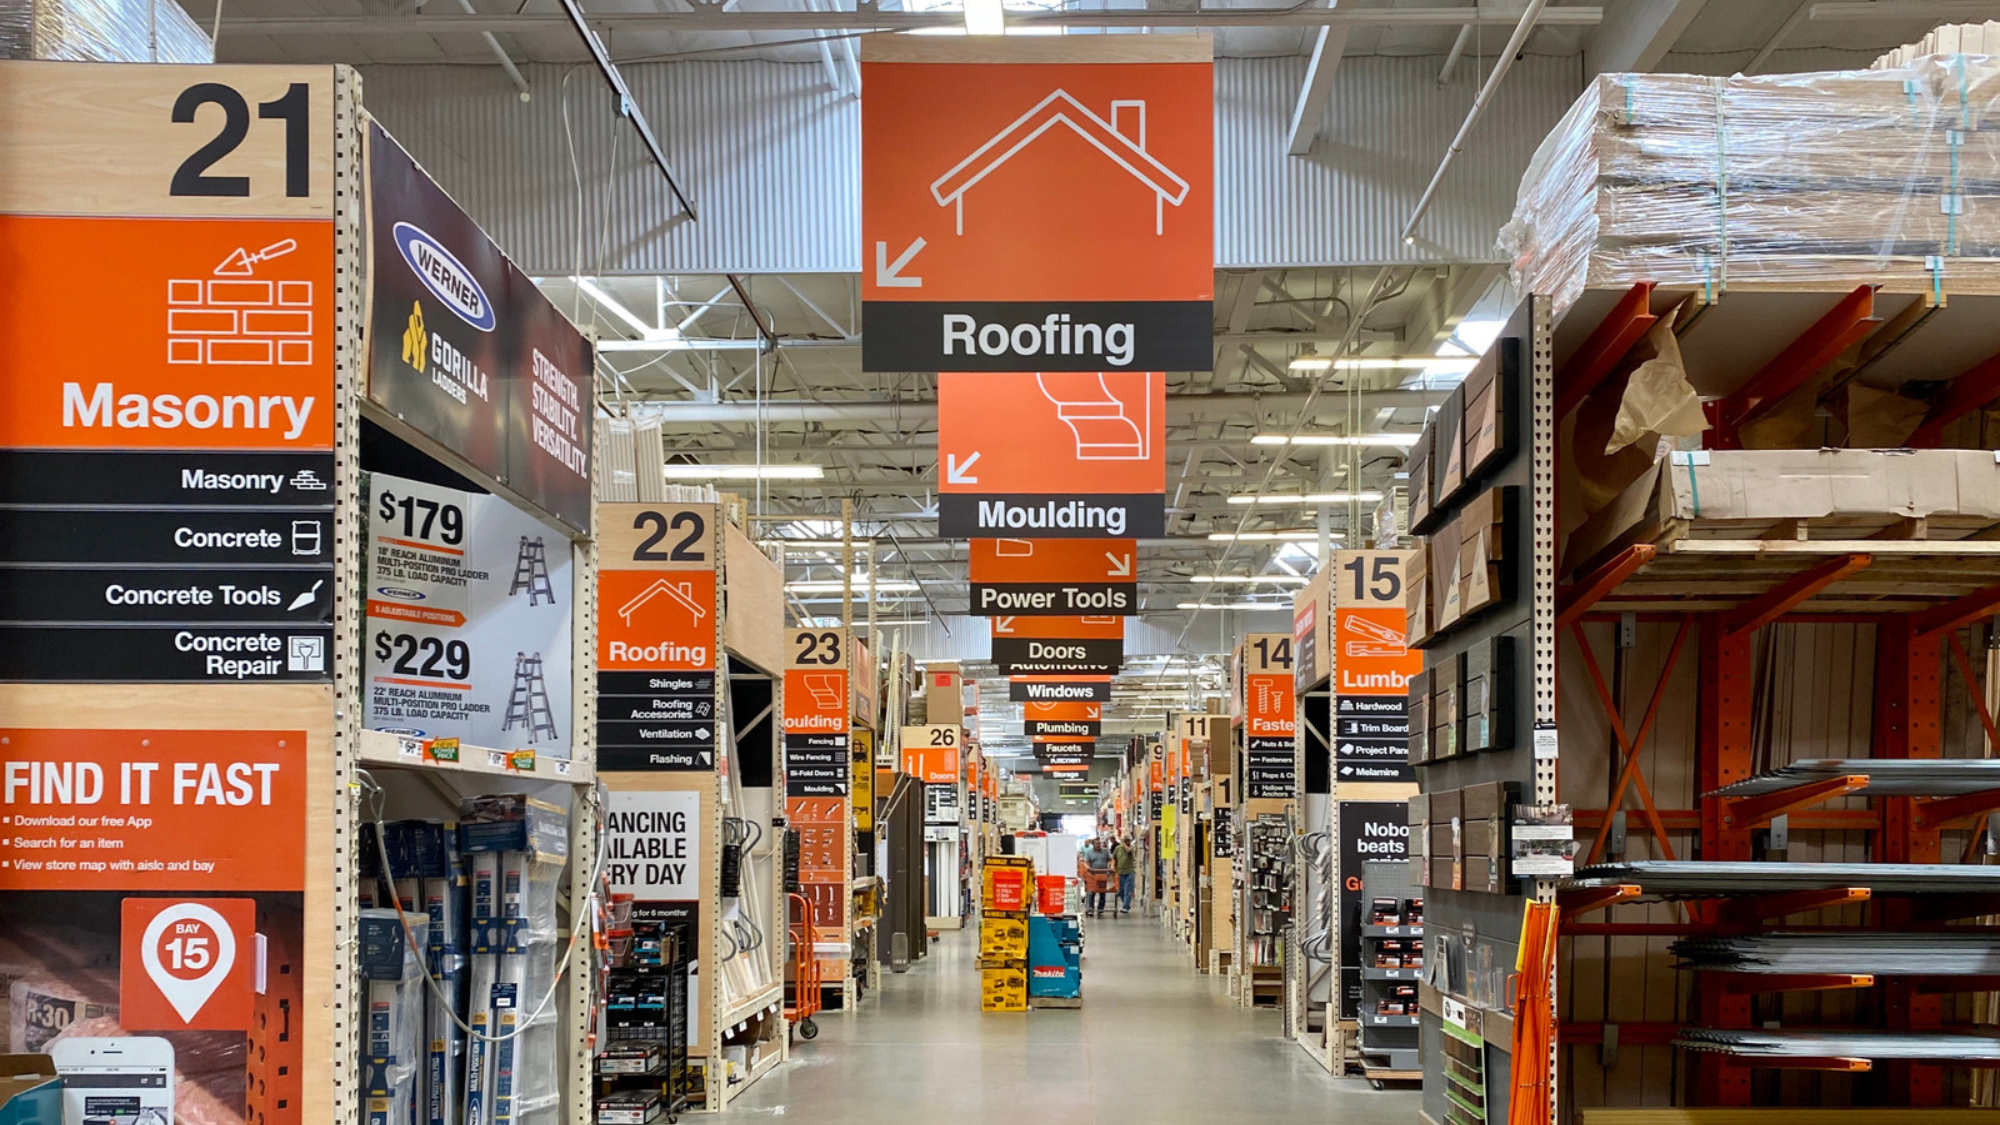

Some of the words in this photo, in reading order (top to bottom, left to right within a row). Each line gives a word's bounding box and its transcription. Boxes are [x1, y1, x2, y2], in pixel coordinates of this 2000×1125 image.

[170, 82, 309, 198] 21
[417, 243, 481, 316] WERNER
[943, 313, 1135, 366] Roofing
[431, 332, 489, 403] GORILLA
[432, 369, 467, 405] LADDERS
[63, 382, 315, 440] Masonry
[182, 469, 285, 494] Masonry
[379, 489, 464, 546] $179
[978, 500, 1126, 536] Moulding
[174, 528, 282, 548] Concrete
[633, 510, 705, 562] 22
[391, 548, 417, 561] REACH
[419, 553, 461, 568] ALUMINUM
[377, 556, 439, 574] MULTI-POSITION
[441, 566, 457, 577] PRO
[458, 568, 489, 580] LADDER
[377, 566, 392, 576] 375
[408, 571, 429, 582] LOAD
[431, 575, 468, 587] CAPACITY
[1344, 556, 1401, 601] 15
[105, 584, 213, 605] Concrete
[219, 585, 281, 606] Tools
[387, 589, 416, 598] WERNER
[981, 588, 1055, 609] Power
[1062, 588, 1127, 609] Tools
[381, 606, 421, 618] ADJUSTABLE
[422, 611, 455, 623] POSITIONS
[175, 632, 282, 653] Concrete
[795, 632, 841, 665] 23
[1029, 643, 1086, 659] Doors
[375, 630, 471, 681] $229
[609, 641, 706, 668] Roofing
[1253, 637, 1293, 669] 14
[206, 655, 282, 679] Repair
[649, 679, 693, 690] Shingles
[1027, 685, 1094, 698] Windows
[389, 687, 416, 698] REACH
[418, 689, 462, 701] ALUMINUM
[373, 696, 439, 709] MULTI-POSITION
[441, 702, 457, 711] PRO
[459, 703, 490, 713] LADDER
[652, 700, 693, 711] Roofing
[1356, 702, 1402, 711] Hardwood
[373, 707, 389, 716] 375
[406, 709, 428, 718] LOAD
[430, 711, 470, 721] CAPACITY
[631, 710, 693, 720] Accessories
[785, 715, 842, 731] oulding
[1037, 723, 1089, 735] Plumbing
[1186, 717, 1205, 736] 11
[1253, 718, 1295, 731] Faste
[1360, 724, 1380, 732] Trim
[639, 729, 692, 739] Ventilation
[808, 738, 834, 746] Fencing
[930, 728, 954, 746] 26
[1046, 744, 1082, 753] Faucets
[1356, 746, 1388, 756] Project
[650, 754, 692, 765] Flashing
[806, 754, 831, 762] Fencing
[1356, 768, 1399, 777] Melamine
[4, 761, 104, 805] FIND
[120, 762, 159, 805] IT
[173, 762, 280, 806] FAST
[804, 786, 834, 794] Moulding
[14, 815, 75, 827] Download
[78, 818, 98, 827] our
[101, 815, 125, 827] free
[127, 816, 152, 829] App
[608, 812, 686, 834] ANCING
[1364, 822, 1409, 837] Nobo
[14, 837, 57, 849] Search
[60, 837, 77, 849] for
[80, 839, 94, 849] an
[97, 837, 124, 849] item
[1357, 838, 1405, 854] beats
[13, 858, 42, 871] View
[45, 860, 77, 871] store
[80, 861, 106, 874] map
[109, 858, 134, 871] with
[137, 858, 164, 871] aisle
[167, 858, 190, 871] and
[193, 859, 215, 874] bay
[646, 864, 686, 885] DAY
[1345, 876, 1363, 891] G
[175, 923, 200, 934] BAY
[165, 938, 210, 970] 15
[27, 998, 70, 1030] R-30
